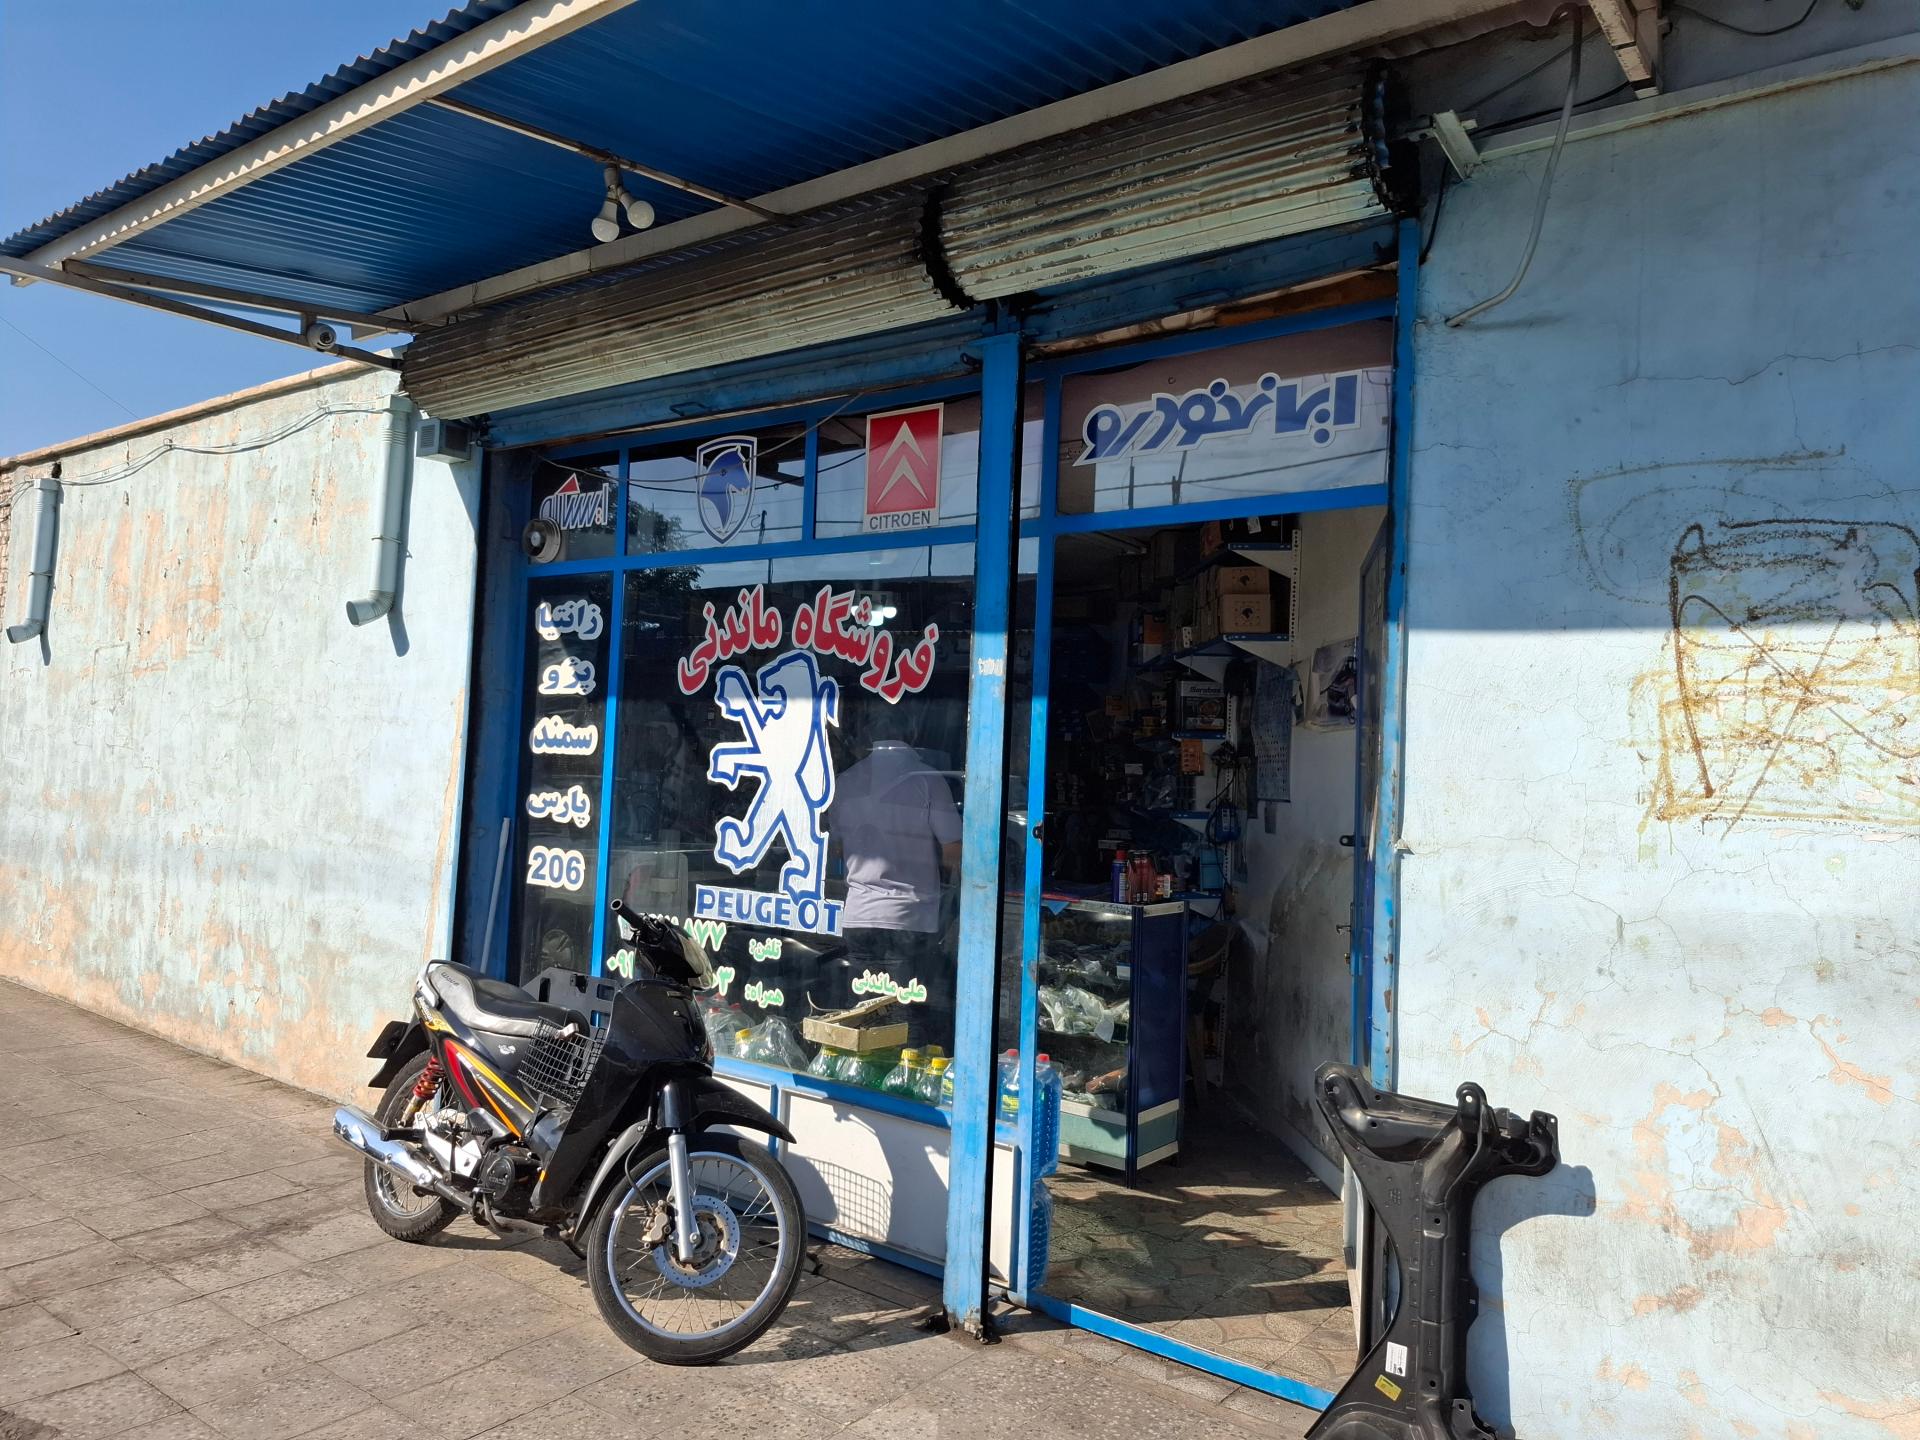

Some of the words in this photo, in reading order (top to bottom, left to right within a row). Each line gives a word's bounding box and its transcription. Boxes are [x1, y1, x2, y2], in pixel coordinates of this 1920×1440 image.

[869, 510, 931, 530] CITROEN
[537, 601, 601, 639] زانتیا
[679, 585, 781, 694] ماندنی
[793, 585, 938, 704] فروشگاه
[531, 718, 596, 752] سمند
[527, 786, 589, 827] پارس
[530, 849, 583, 888] 206
[696, 888, 842, 933] PEUGEOT
[852, 969, 898, 995] ماندنی
[897, 978, 927, 1004] علی
